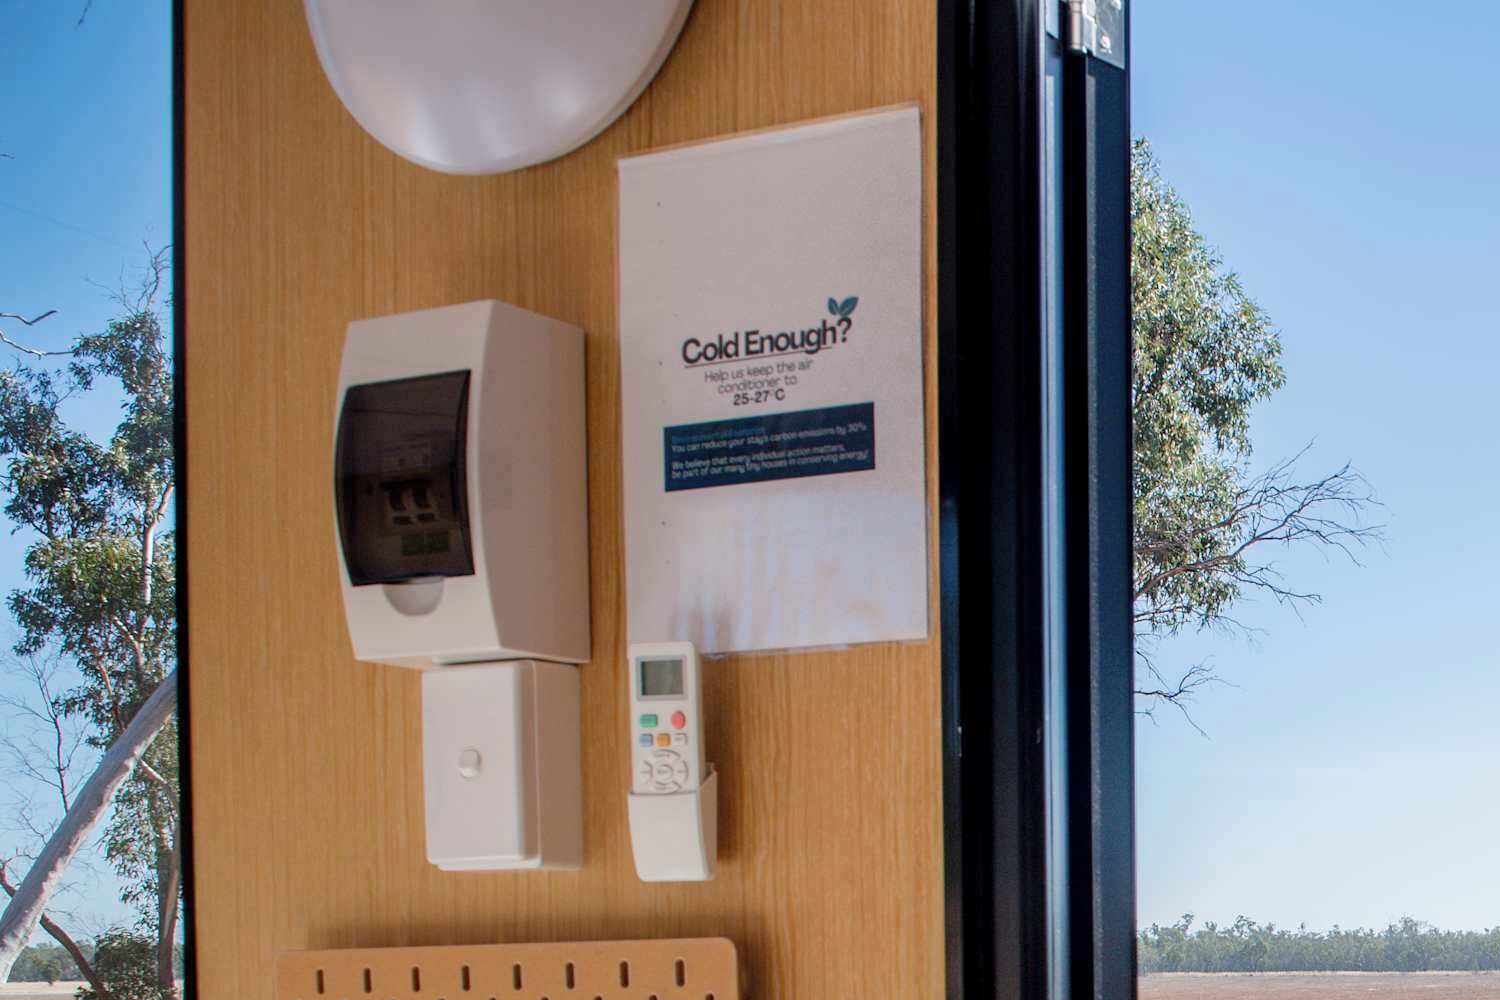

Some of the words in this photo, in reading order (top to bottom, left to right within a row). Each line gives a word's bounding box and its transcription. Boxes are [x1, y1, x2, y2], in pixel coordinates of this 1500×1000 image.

[682, 332, 739, 364] Cold
[744, 317, 852, 355] Enough?
[704, 369, 728, 382] Help
[731, 368, 744, 379] us
[747, 364, 774, 379] keep
[776, 361, 796, 373] the
[798, 358, 813, 371] air
[718, 375, 780, 395] conditioner
[783, 373, 798, 385] to
